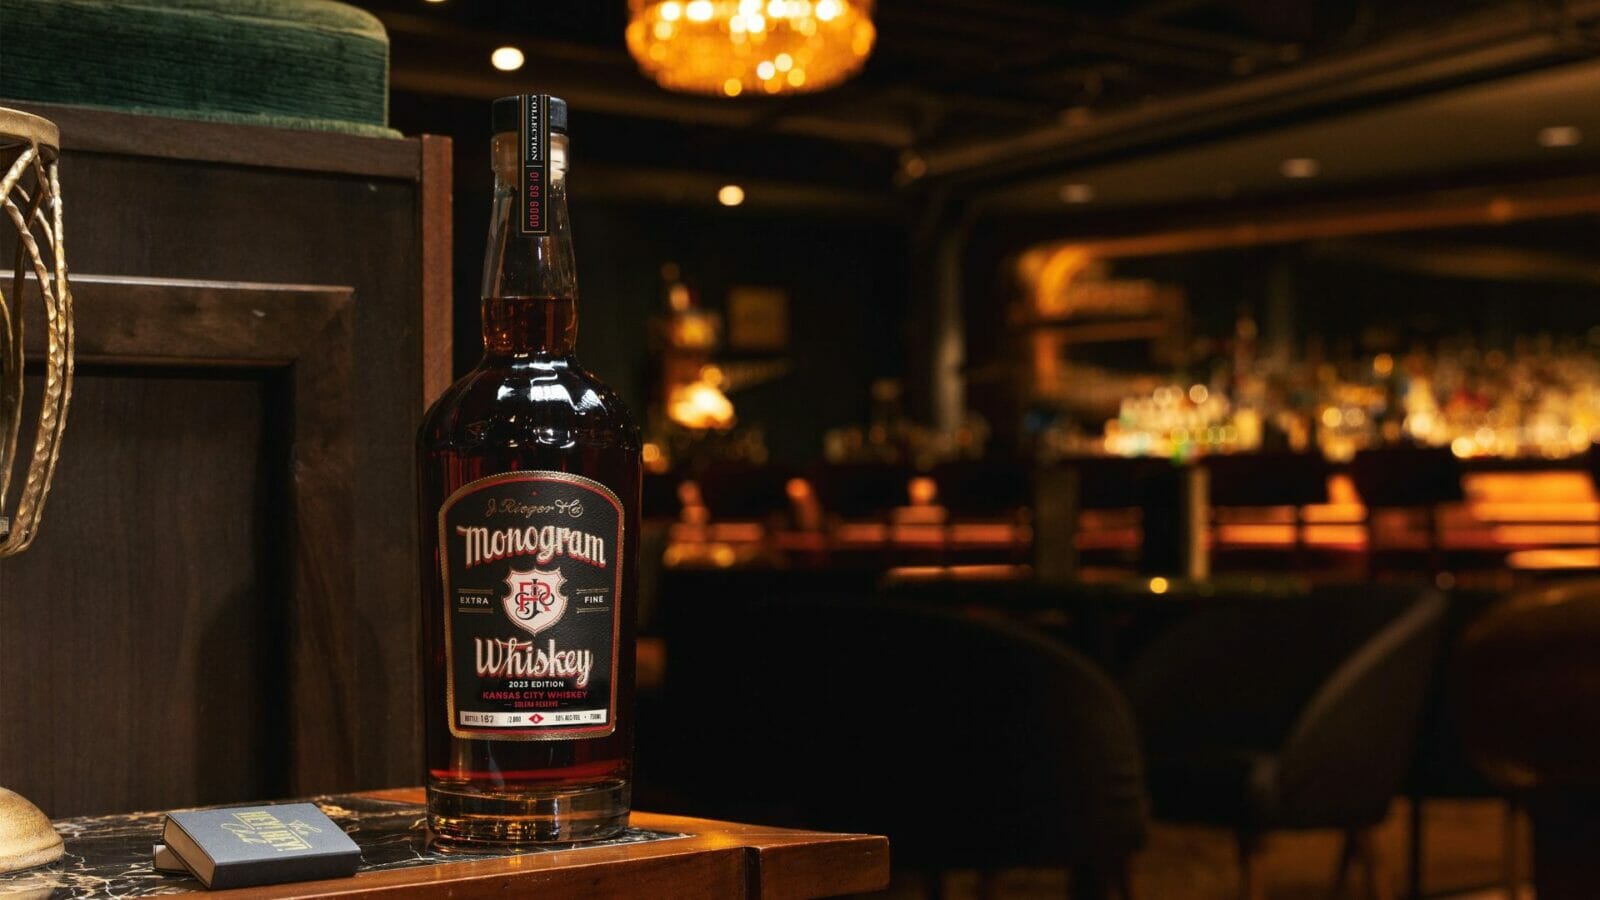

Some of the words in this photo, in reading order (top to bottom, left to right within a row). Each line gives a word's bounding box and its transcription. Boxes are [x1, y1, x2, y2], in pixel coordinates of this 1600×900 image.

[529, 201, 540, 228] GOOD
[456, 525, 606, 567] Monogram
[459, 596, 489, 605] EXTRA
[584, 595, 604, 604] FINE
[474, 637, 594, 688] Whiskey
[508, 680, 529, 688] 2023
[531, 680, 565, 688] EDITION
[482, 691, 521, 700] KANSAS
[523, 691, 545, 699] CITY
[547, 690, 588, 699] WHISKEY
